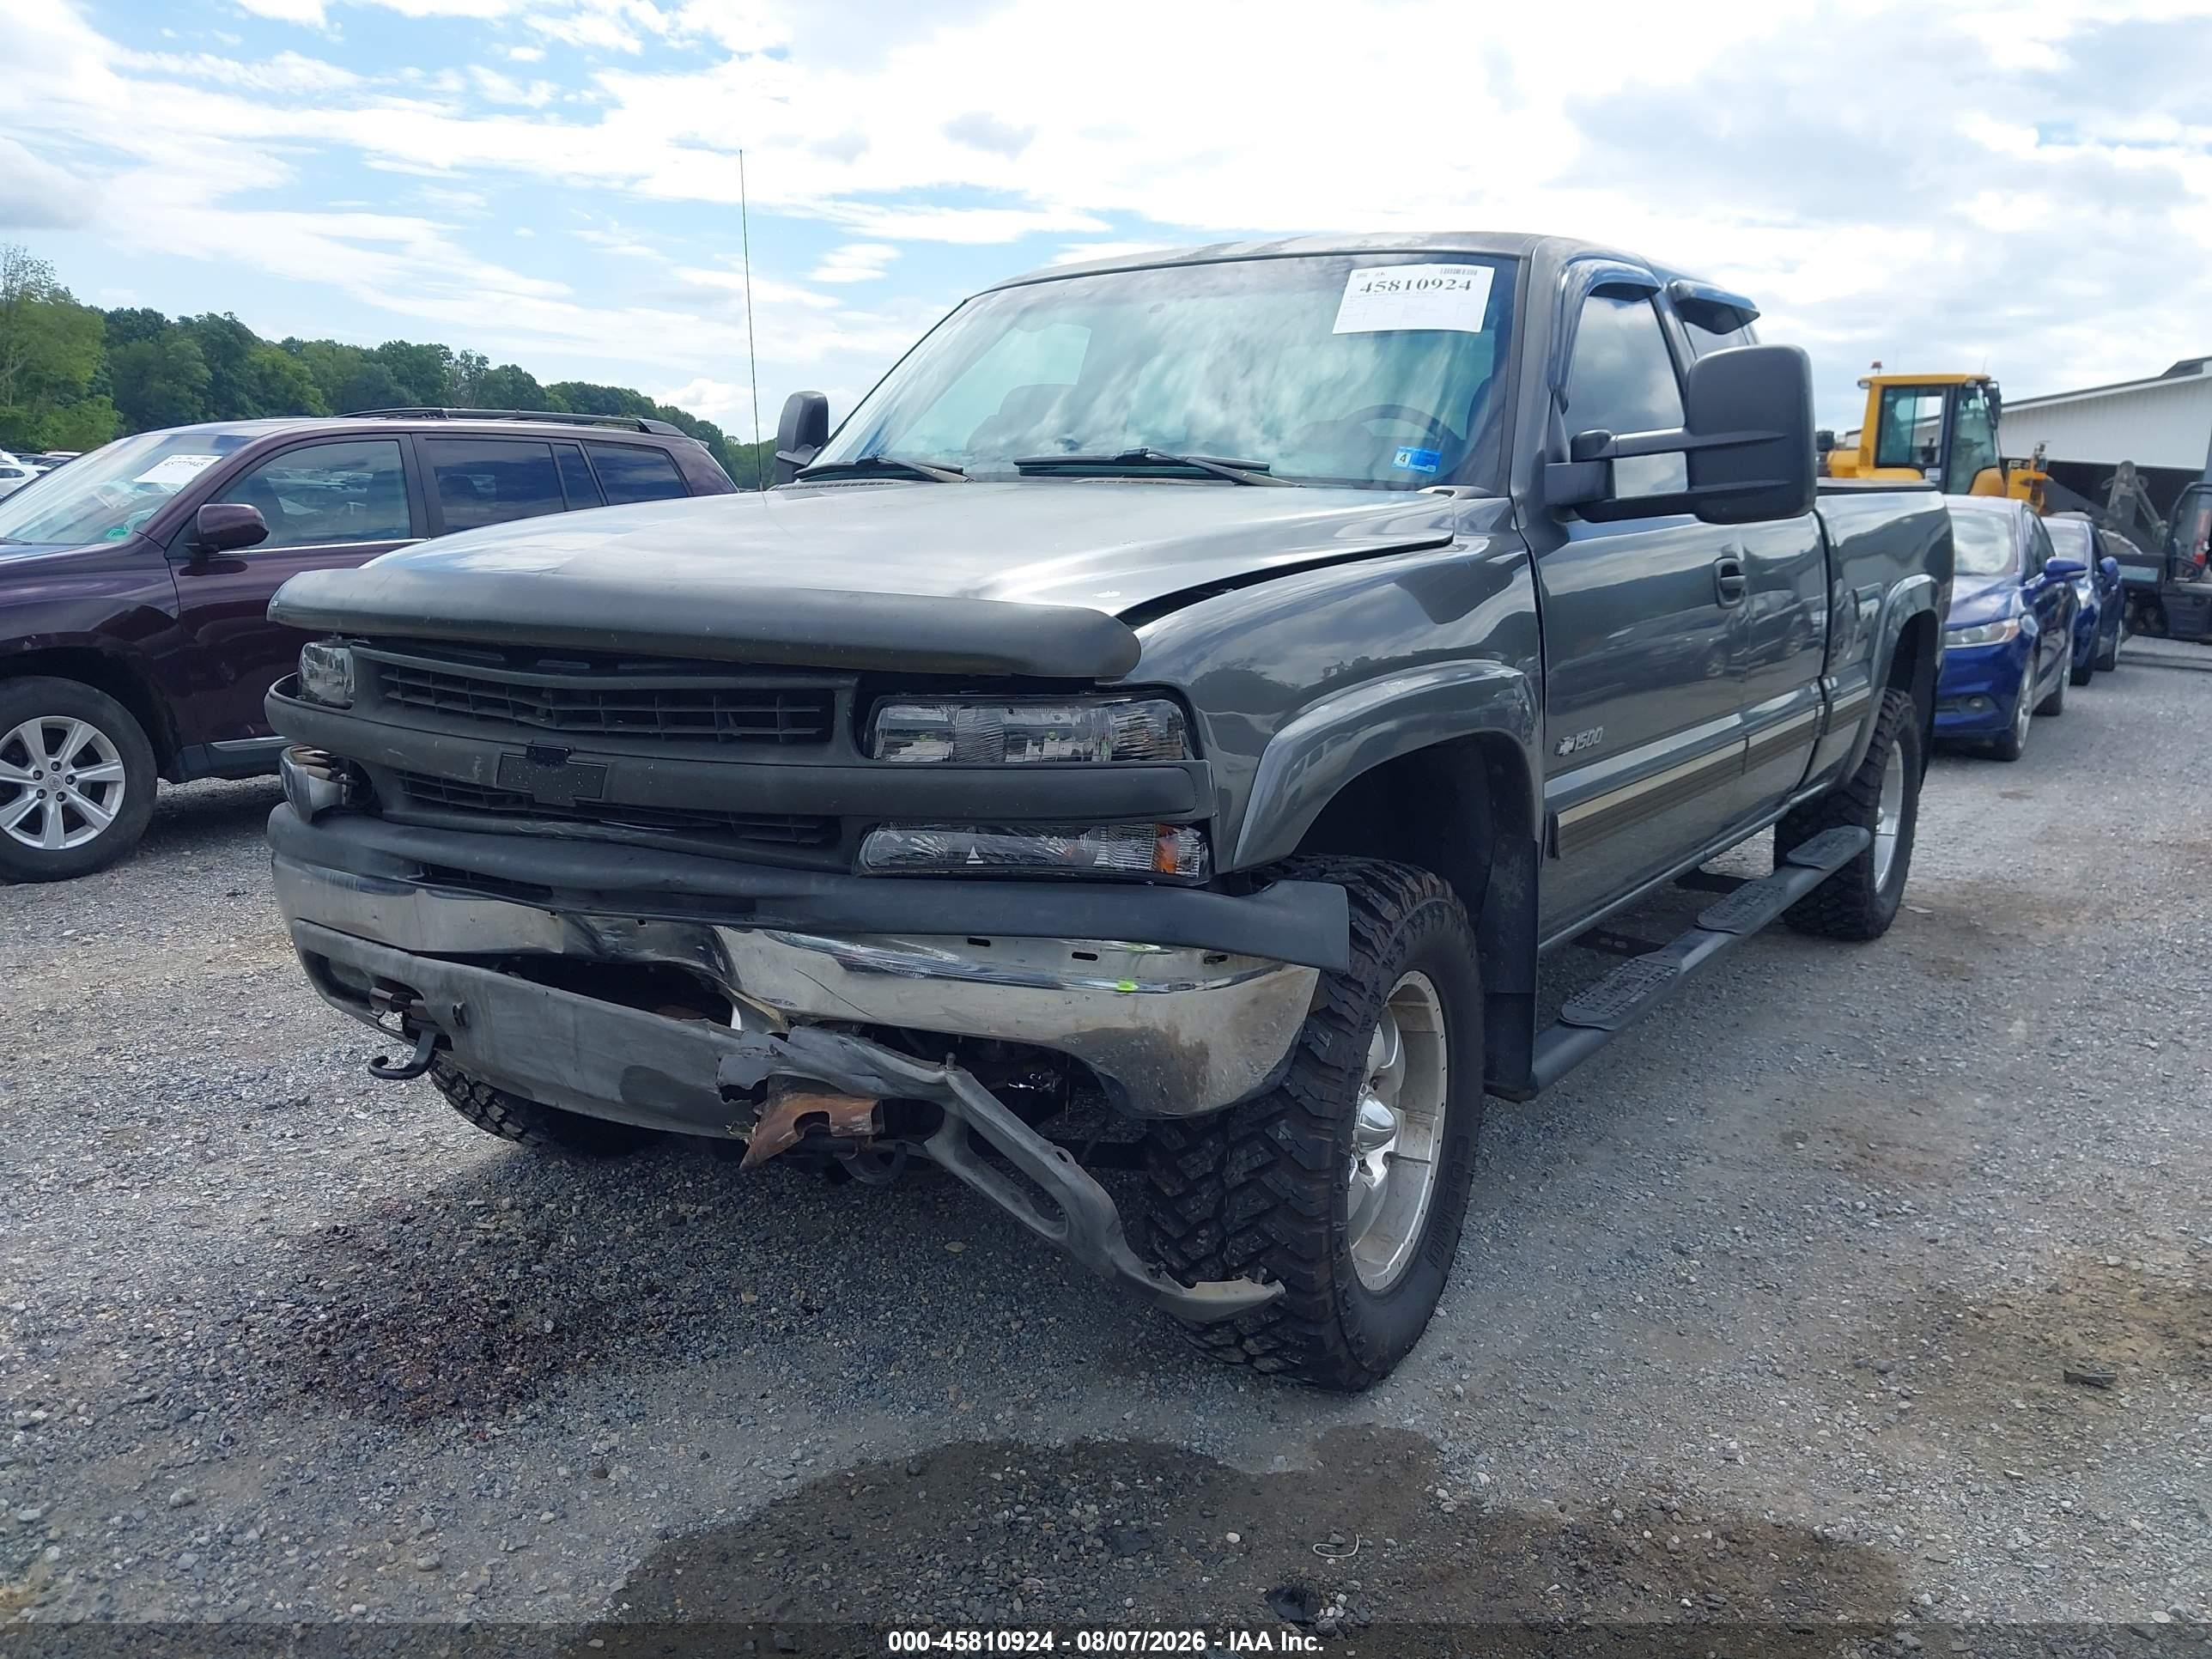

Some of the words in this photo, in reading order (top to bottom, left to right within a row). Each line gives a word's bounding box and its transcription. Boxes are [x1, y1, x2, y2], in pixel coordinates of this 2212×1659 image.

[1359, 277, 1473, 294] 45810924
[1399, 453, 1407, 463] 4
[1574, 726, 1604, 751] 1500
